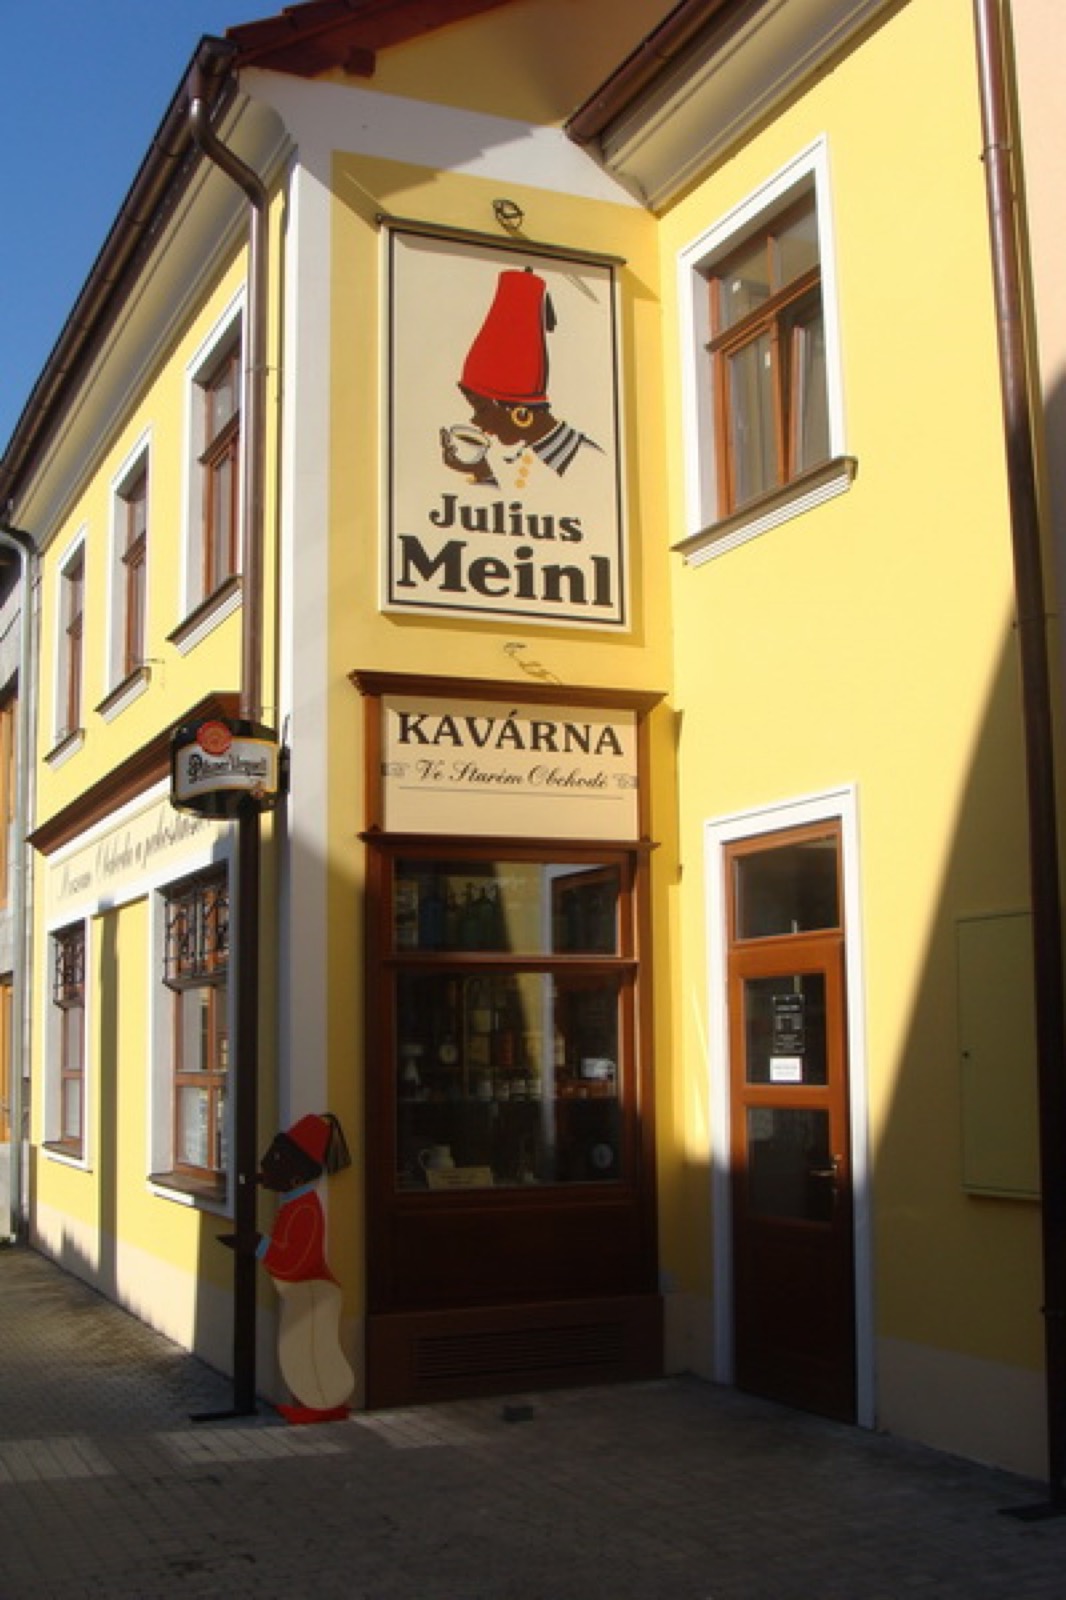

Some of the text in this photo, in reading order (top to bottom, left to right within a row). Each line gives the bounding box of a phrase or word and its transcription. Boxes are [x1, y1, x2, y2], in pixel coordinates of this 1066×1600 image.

[429, 493, 583, 542] Julius
[396, 534, 613, 607] Meinl
[397, 709, 624, 756] KAVÁRNA
[416, 760, 446, 781] Ve
